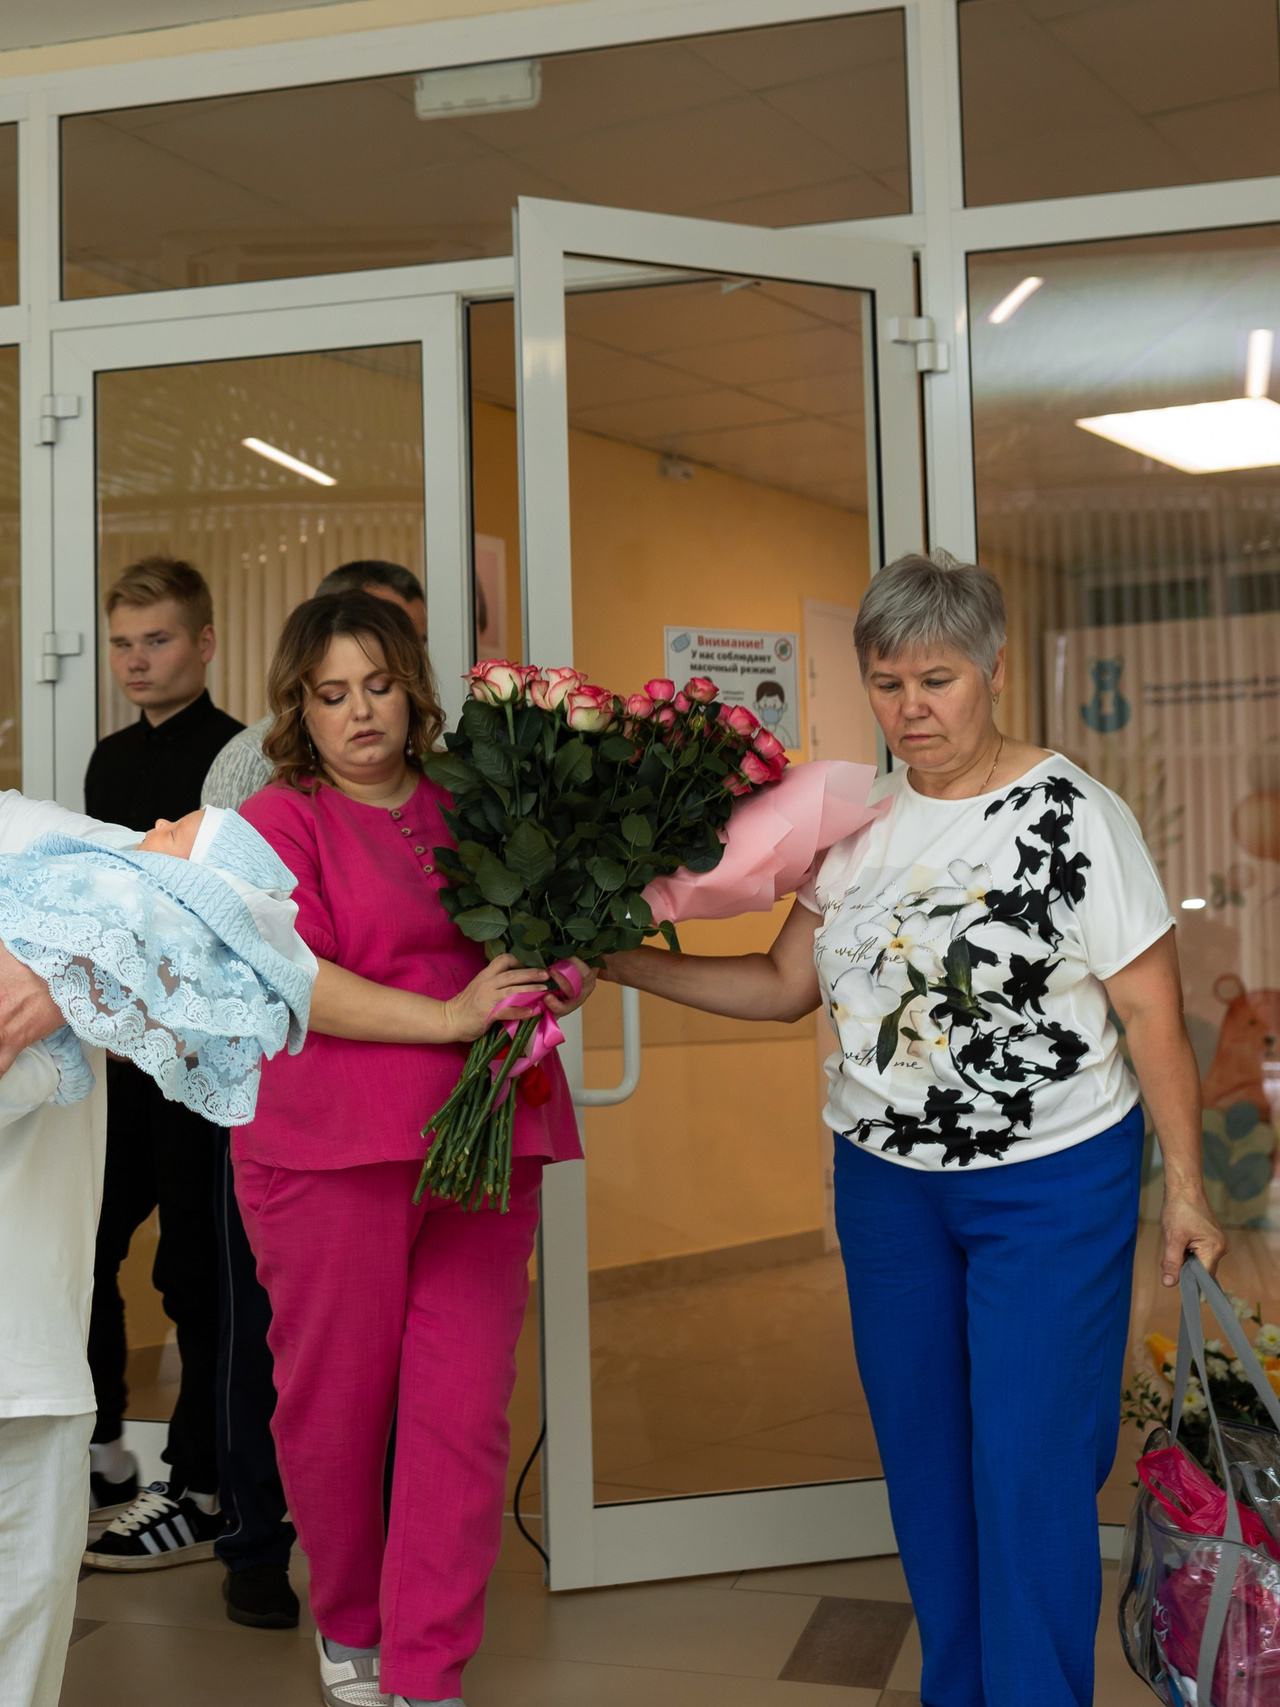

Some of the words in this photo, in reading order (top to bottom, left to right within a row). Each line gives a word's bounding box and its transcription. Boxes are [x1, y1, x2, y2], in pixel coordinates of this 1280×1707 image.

[698, 635, 764, 650] Внимание!
[691, 649, 698, 660] У
[699, 651, 715, 660] нас
[717, 651, 771, 663] соблюдают
[690, 663, 738, 673] масочный
[740, 666, 776, 676] режим!
